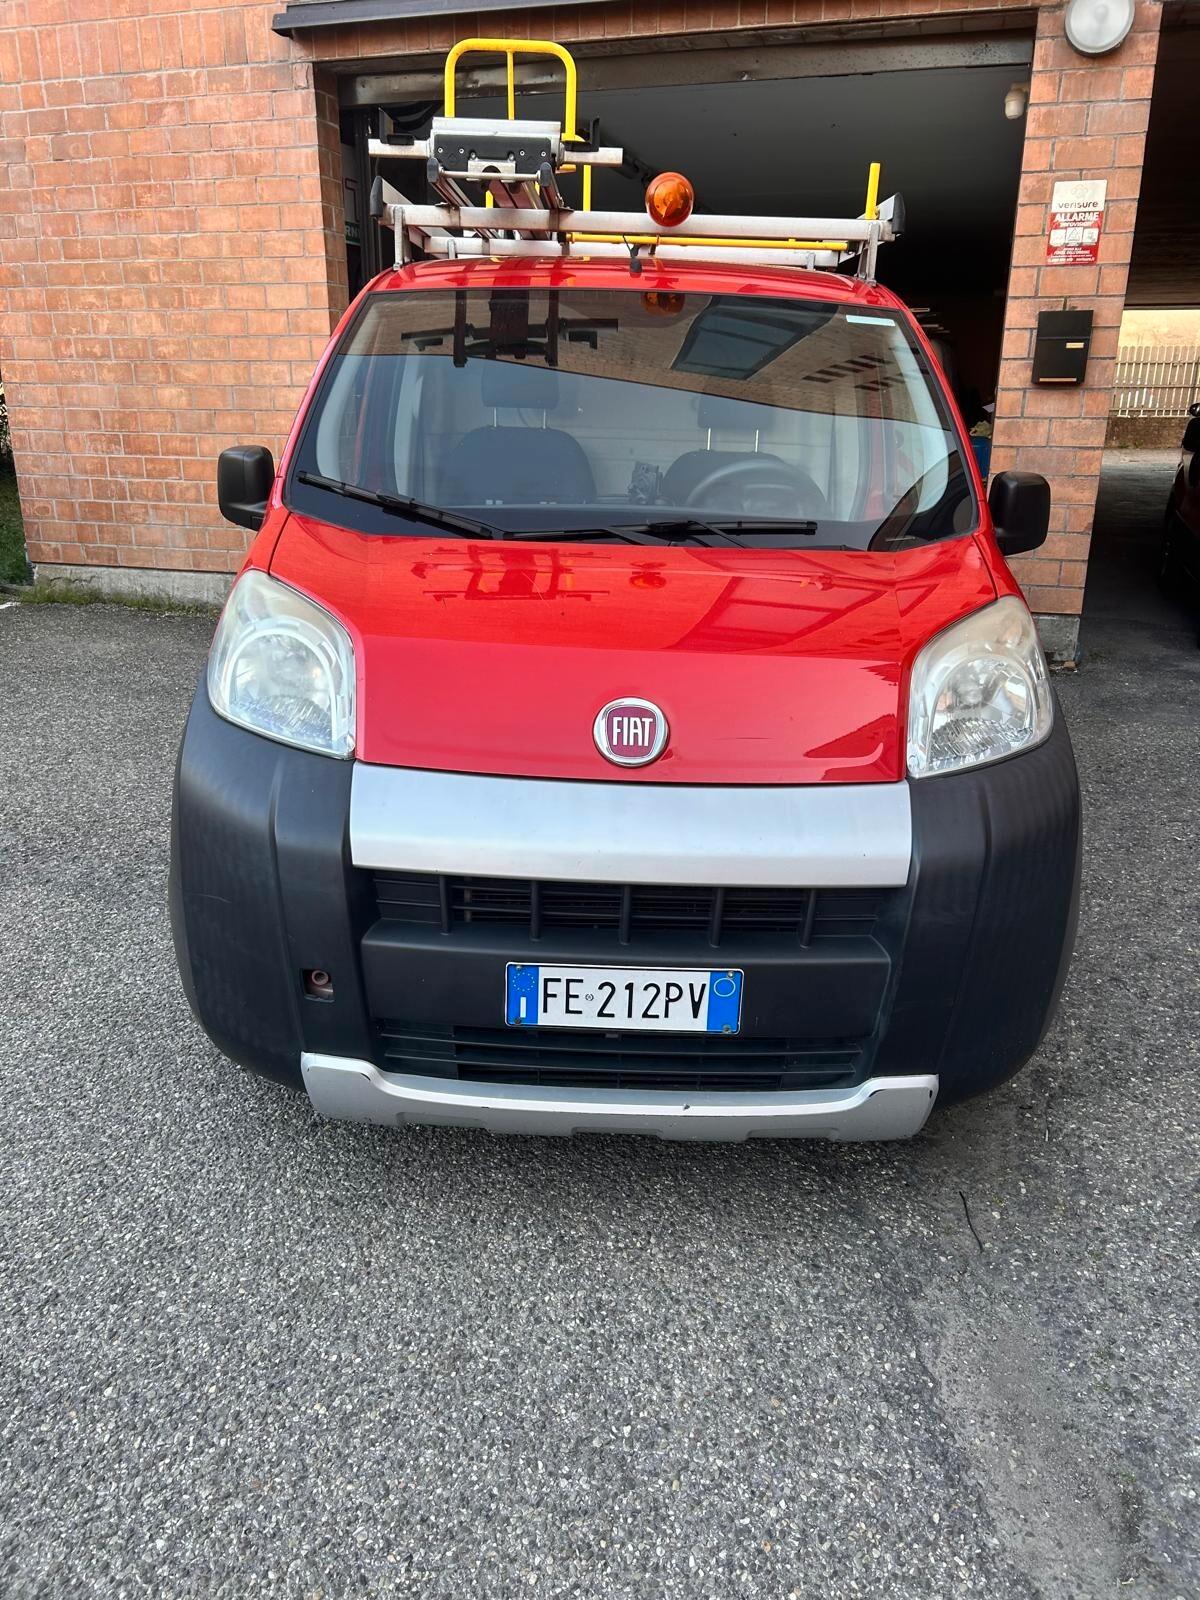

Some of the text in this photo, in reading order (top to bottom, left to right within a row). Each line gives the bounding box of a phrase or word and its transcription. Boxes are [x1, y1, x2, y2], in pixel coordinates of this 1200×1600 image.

[1058, 200, 1099, 209] verisure
[1053, 212, 1100, 222] ALLARME
[612, 716, 654, 747] FIAT
[519, 996, 527, 1018] I
[542, 977, 707, 1020] FE 212PV
